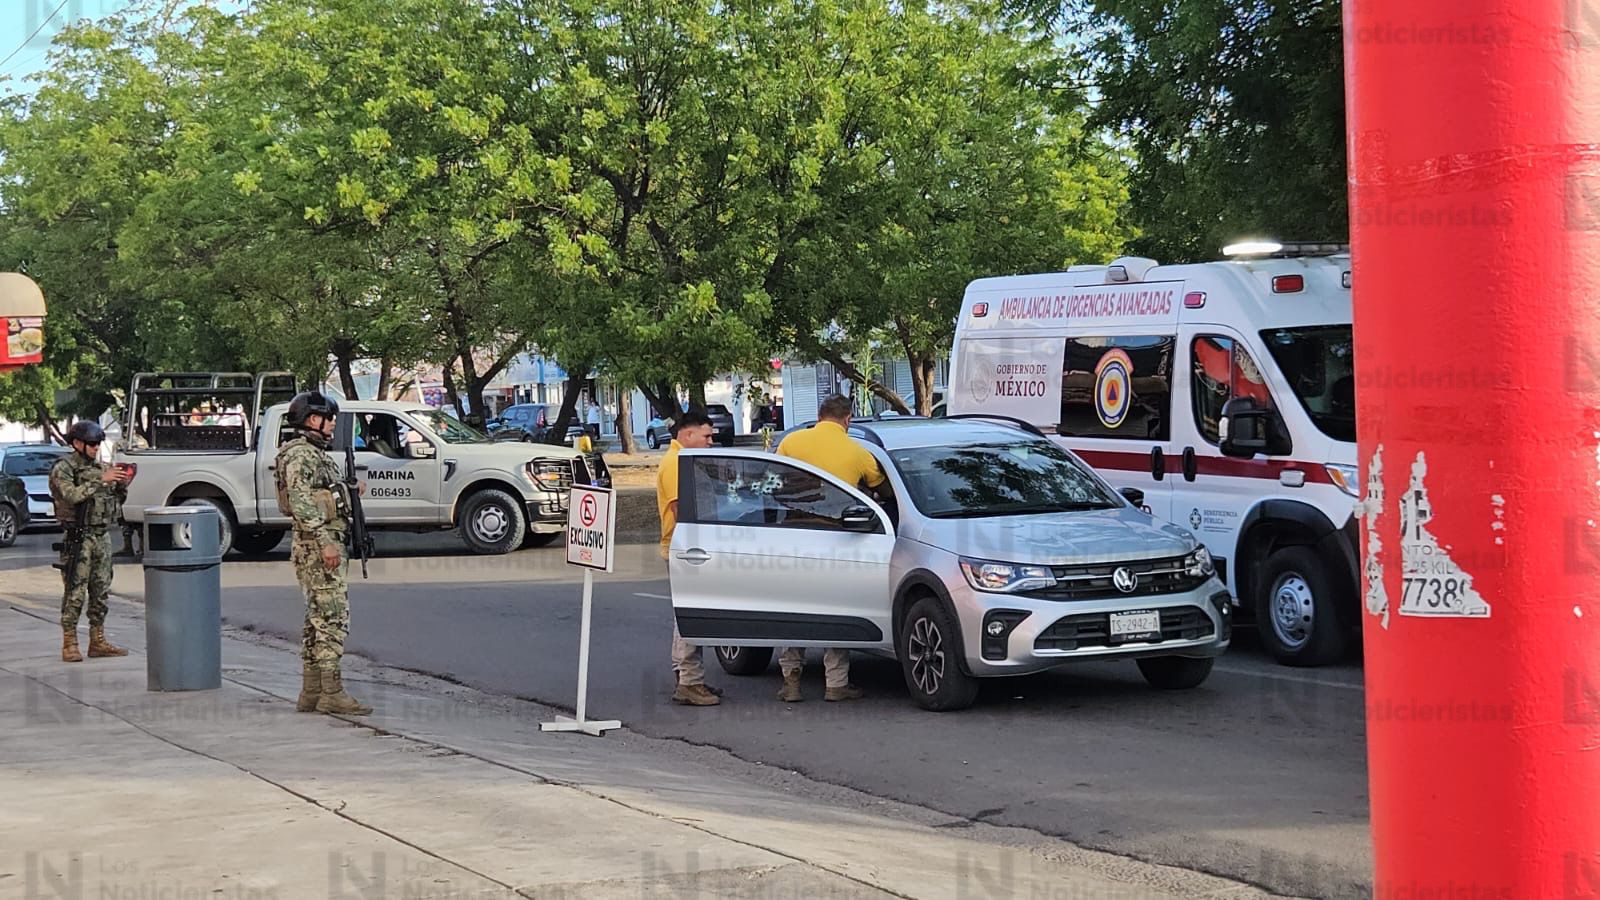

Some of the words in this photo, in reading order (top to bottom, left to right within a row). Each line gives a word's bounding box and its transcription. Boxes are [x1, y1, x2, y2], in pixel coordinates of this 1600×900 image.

[999, 297, 1051, 320] AMBULANCIA
[1052, 295, 1065, 318] DE
[1066, 292, 1116, 318] URGENCIAS
[1114, 290, 1173, 316] AVANZADAS
[996, 364, 1035, 375] GOBIERNO
[1036, 364, 1047, 375] DE
[995, 375, 1046, 397] MÉXICO
[368, 470, 415, 480] MARINA
[371, 487, 412, 497] 606493
[570, 526, 604, 550] EXCLUSIVO
[1112, 617, 1158, 632] TS-2942-A
